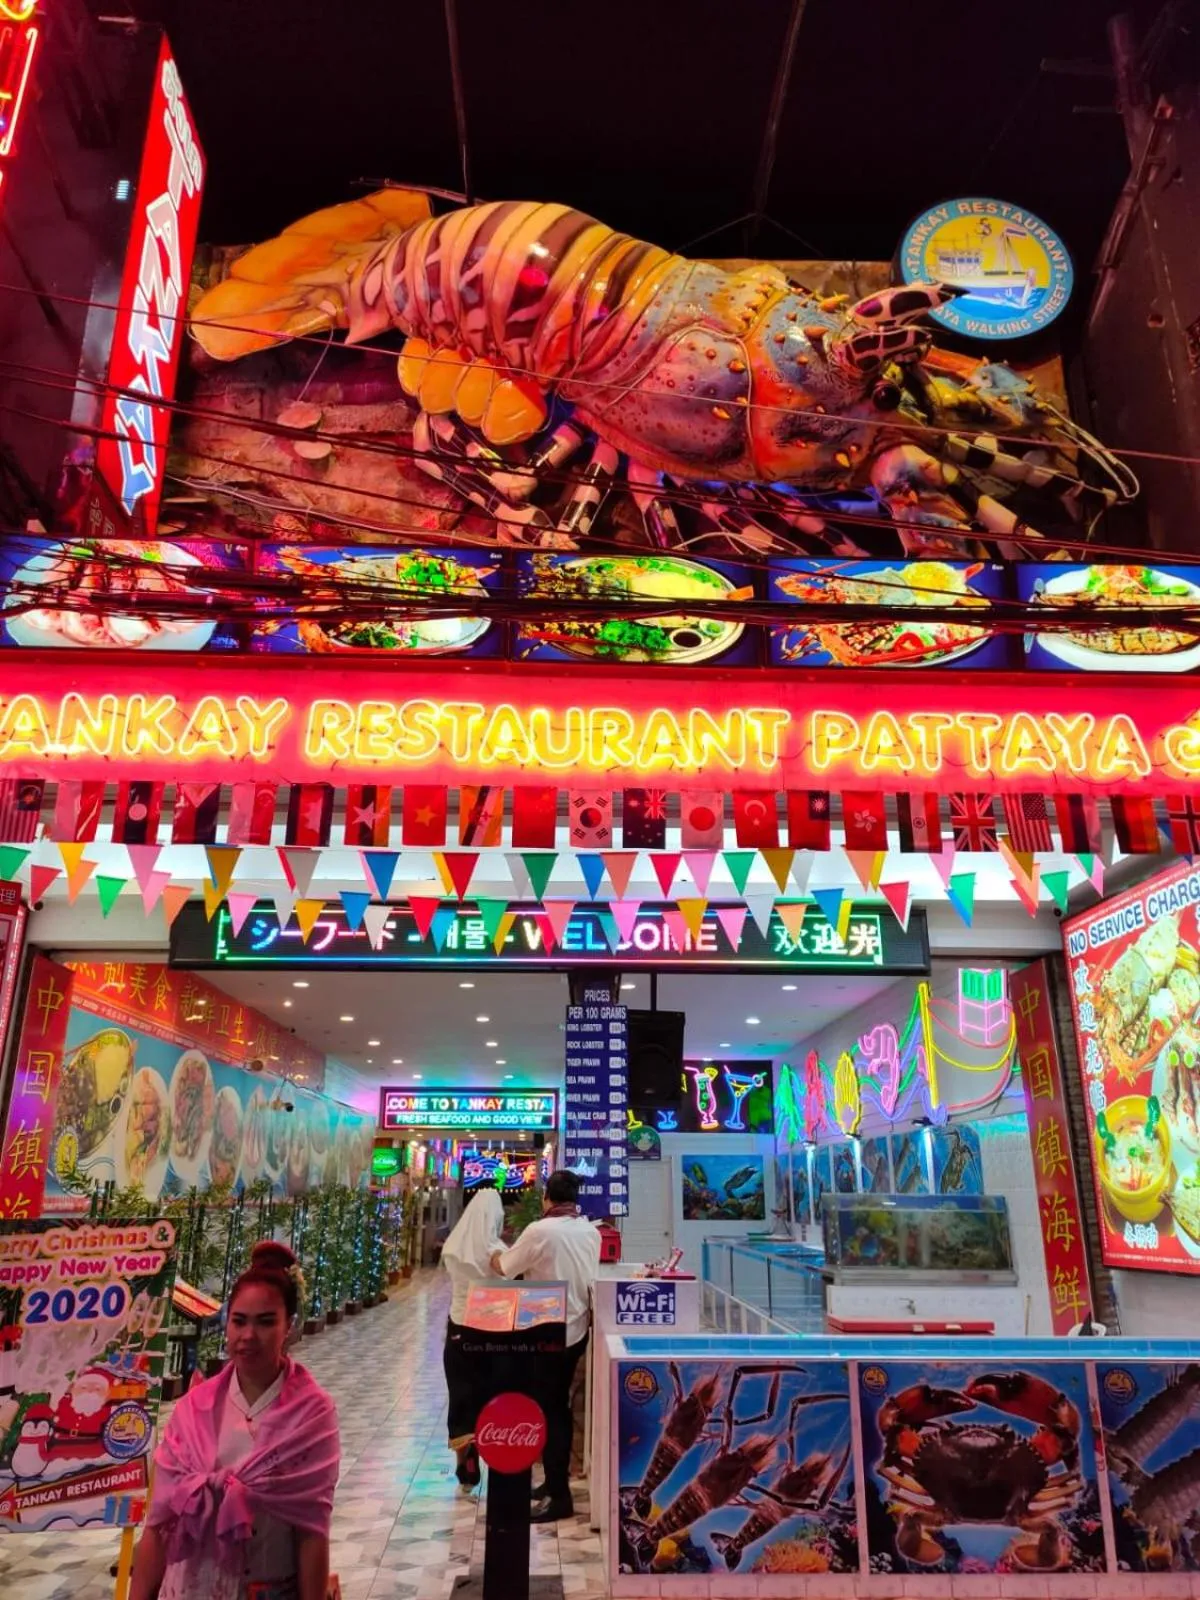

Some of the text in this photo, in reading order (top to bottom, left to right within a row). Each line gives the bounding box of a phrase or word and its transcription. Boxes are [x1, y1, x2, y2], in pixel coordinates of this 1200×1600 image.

[907, 201, 1068, 272] TANKAY RESTAURANT
[114, 108, 194, 515] TANKAY
[966, 319, 1032, 336] WALKING
[1033, 283, 1065, 324] STREET
[304, 699, 791, 769] RESTAURANT
[810, 709, 1151, 777] PATTAYA
[1070, 932, 1086, 956] NO
[1089, 903, 1143, 945] SERVICE
[584, 989, 610, 1002] PRICES
[568, 1006, 627, 1020] PER 100 GRAMS
[580, 1023, 603, 1033] LOBSTER
[567, 1040, 604, 1050] ROCK LOBSTER
[431, 1097, 450, 1110] TO
[452, 1097, 504, 1110] TANKAY
[396, 1114, 543, 1124] FRESH SEAFOOD AND GOOD VIEW
[1018, 982, 1087, 1323] 中国镇海鲜
[46, 1230, 147, 1250] Christmas
[156, 1226, 169, 1241] &
[0, 1255, 161, 1283] appy New Year
[25, 1285, 125, 1323] 2020
[618, 1292, 674, 1312] Wi-Fi
[620, 1313, 672, 1323] FREE
[478, 1422, 544, 1447] Coca-Cola
[15, 1488, 62, 1509] TANKAY
[67, 1469, 141, 1496] RESTAURANT
